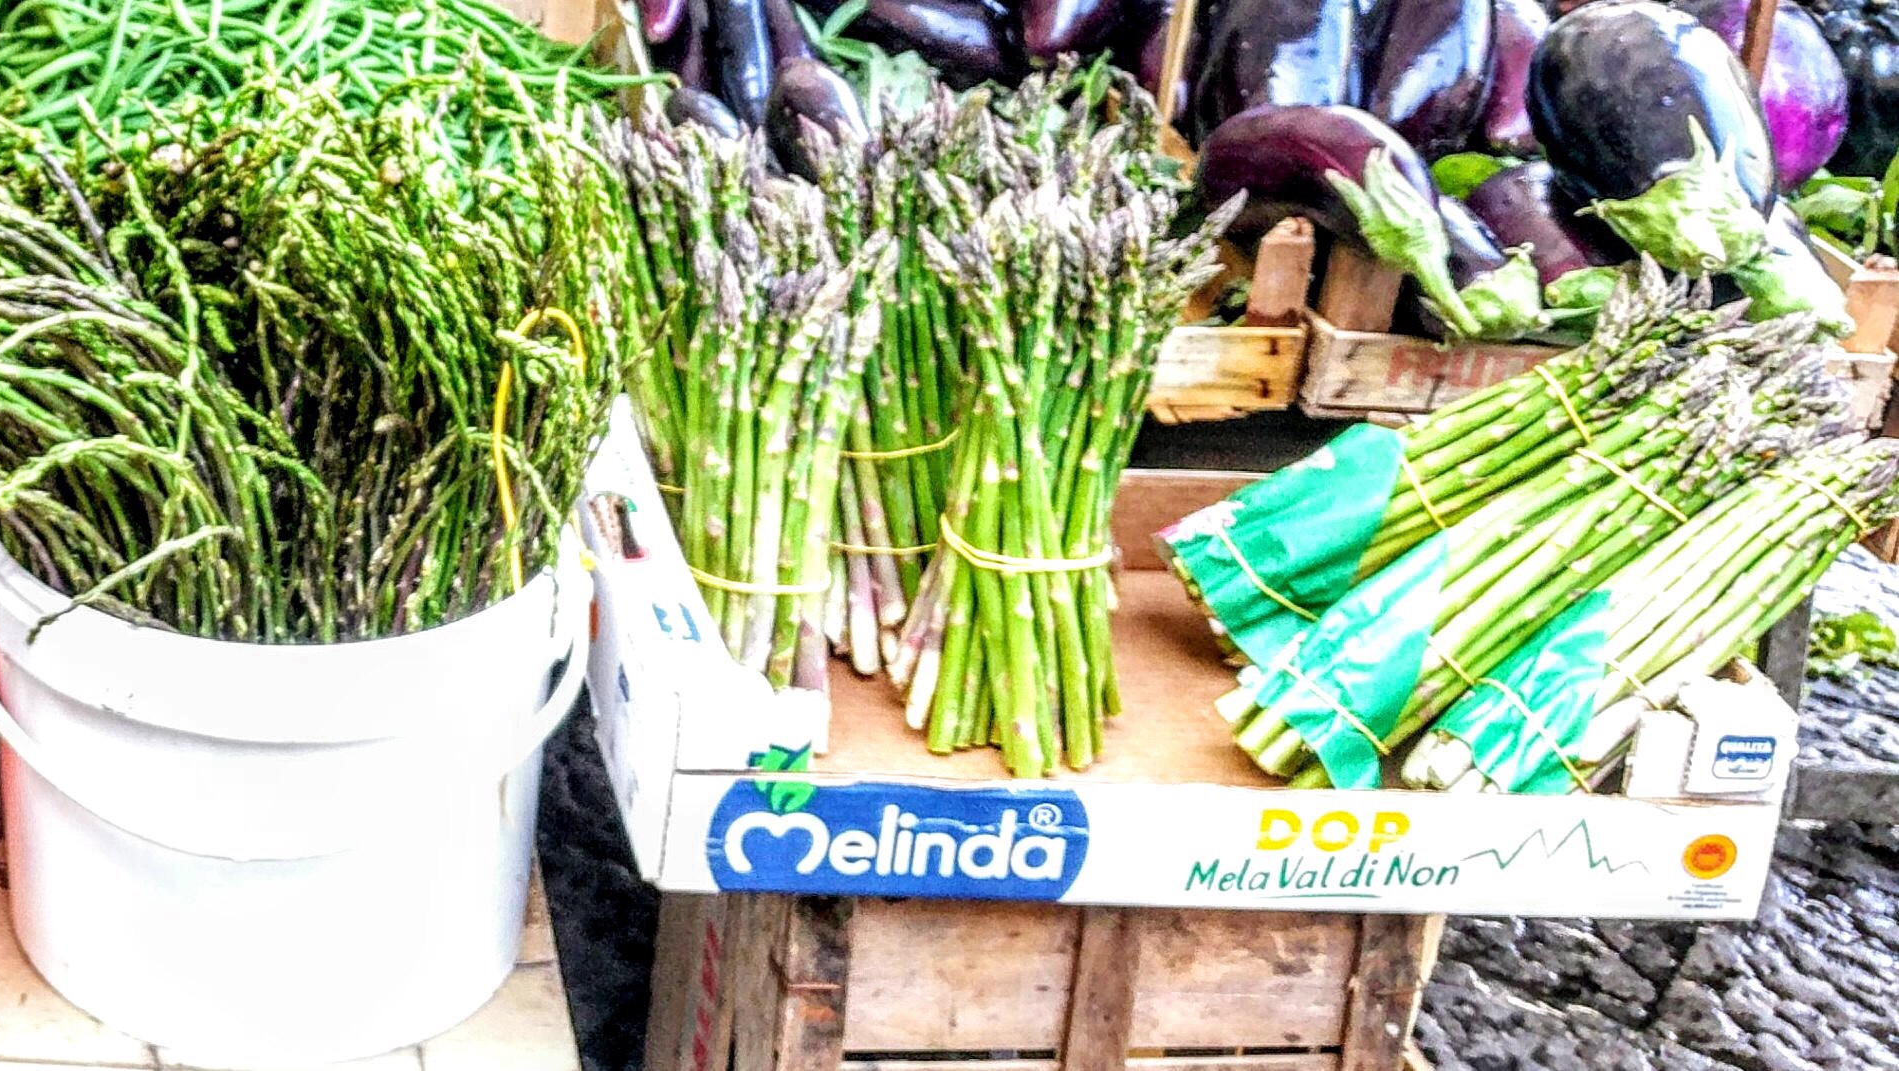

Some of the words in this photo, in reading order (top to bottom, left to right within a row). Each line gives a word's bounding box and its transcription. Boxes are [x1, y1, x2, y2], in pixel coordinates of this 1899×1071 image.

[1255, 808, 1411, 854] DOP
[1185, 856, 1270, 893] Mela
[1277, 854, 1331, 891] Val
[1338, 851, 1377, 889] di
[1383, 852, 1461, 890] Non
